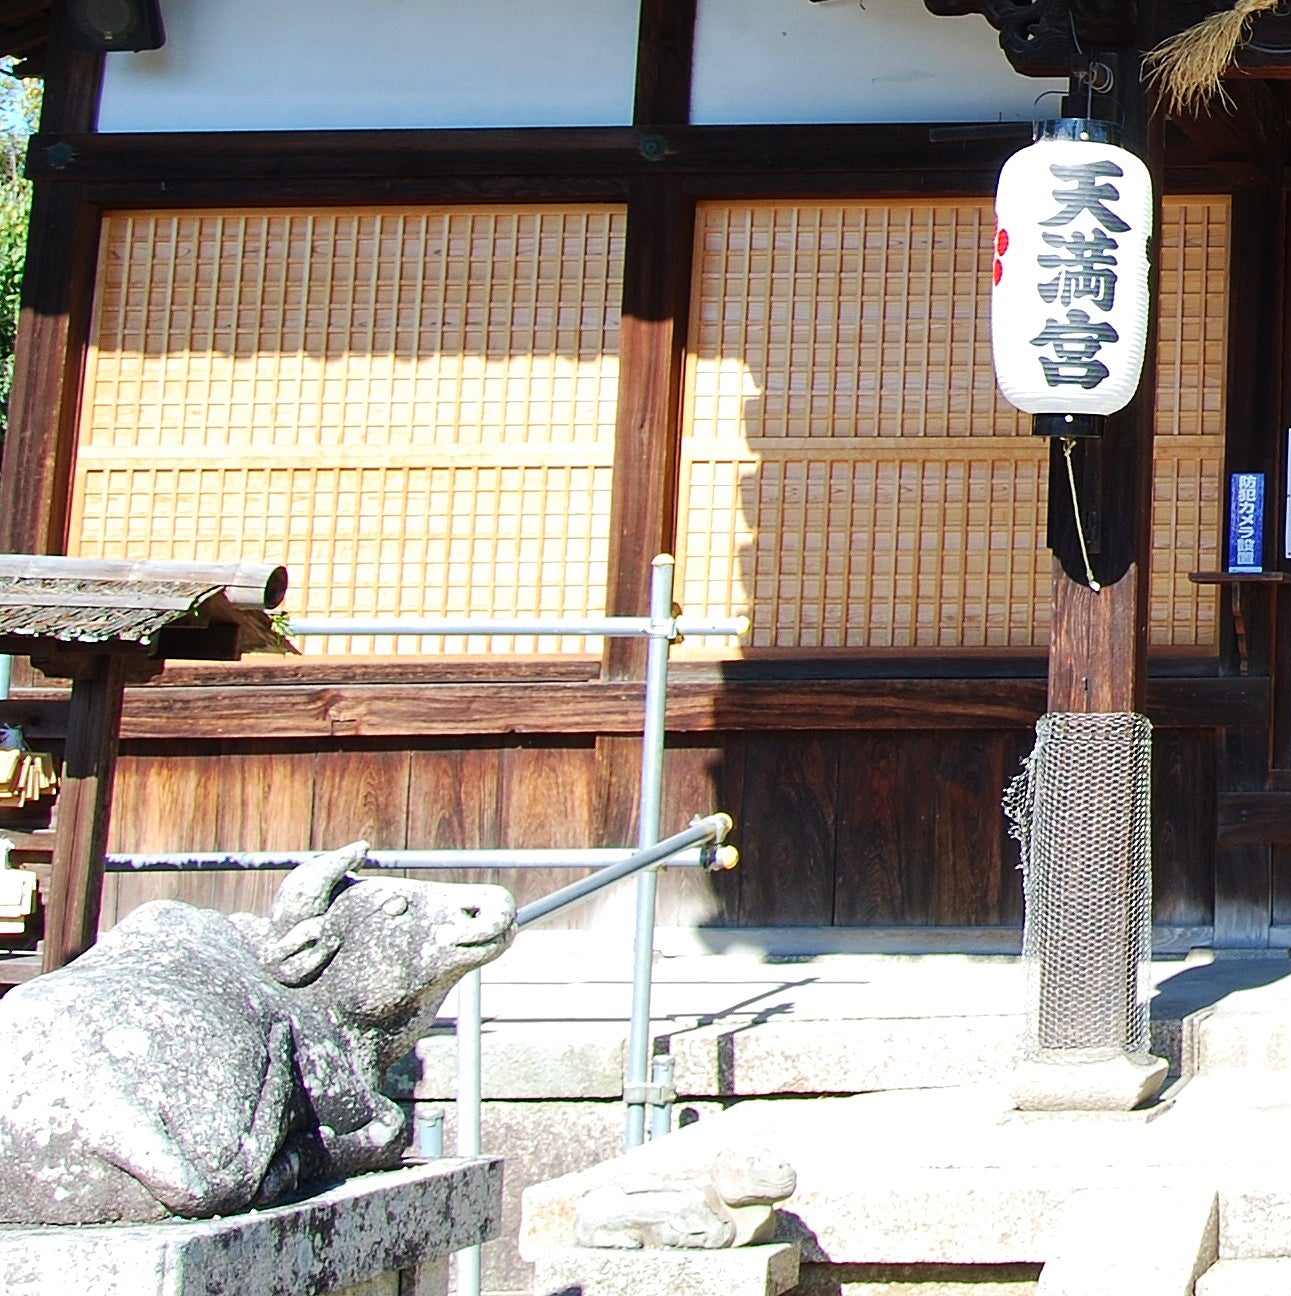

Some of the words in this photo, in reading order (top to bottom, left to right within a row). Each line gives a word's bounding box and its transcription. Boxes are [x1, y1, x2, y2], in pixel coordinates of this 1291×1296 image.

[1029, 159, 1132, 389] 天満宮
[1237, 475, 1257, 565] 防犯カメラ設置
